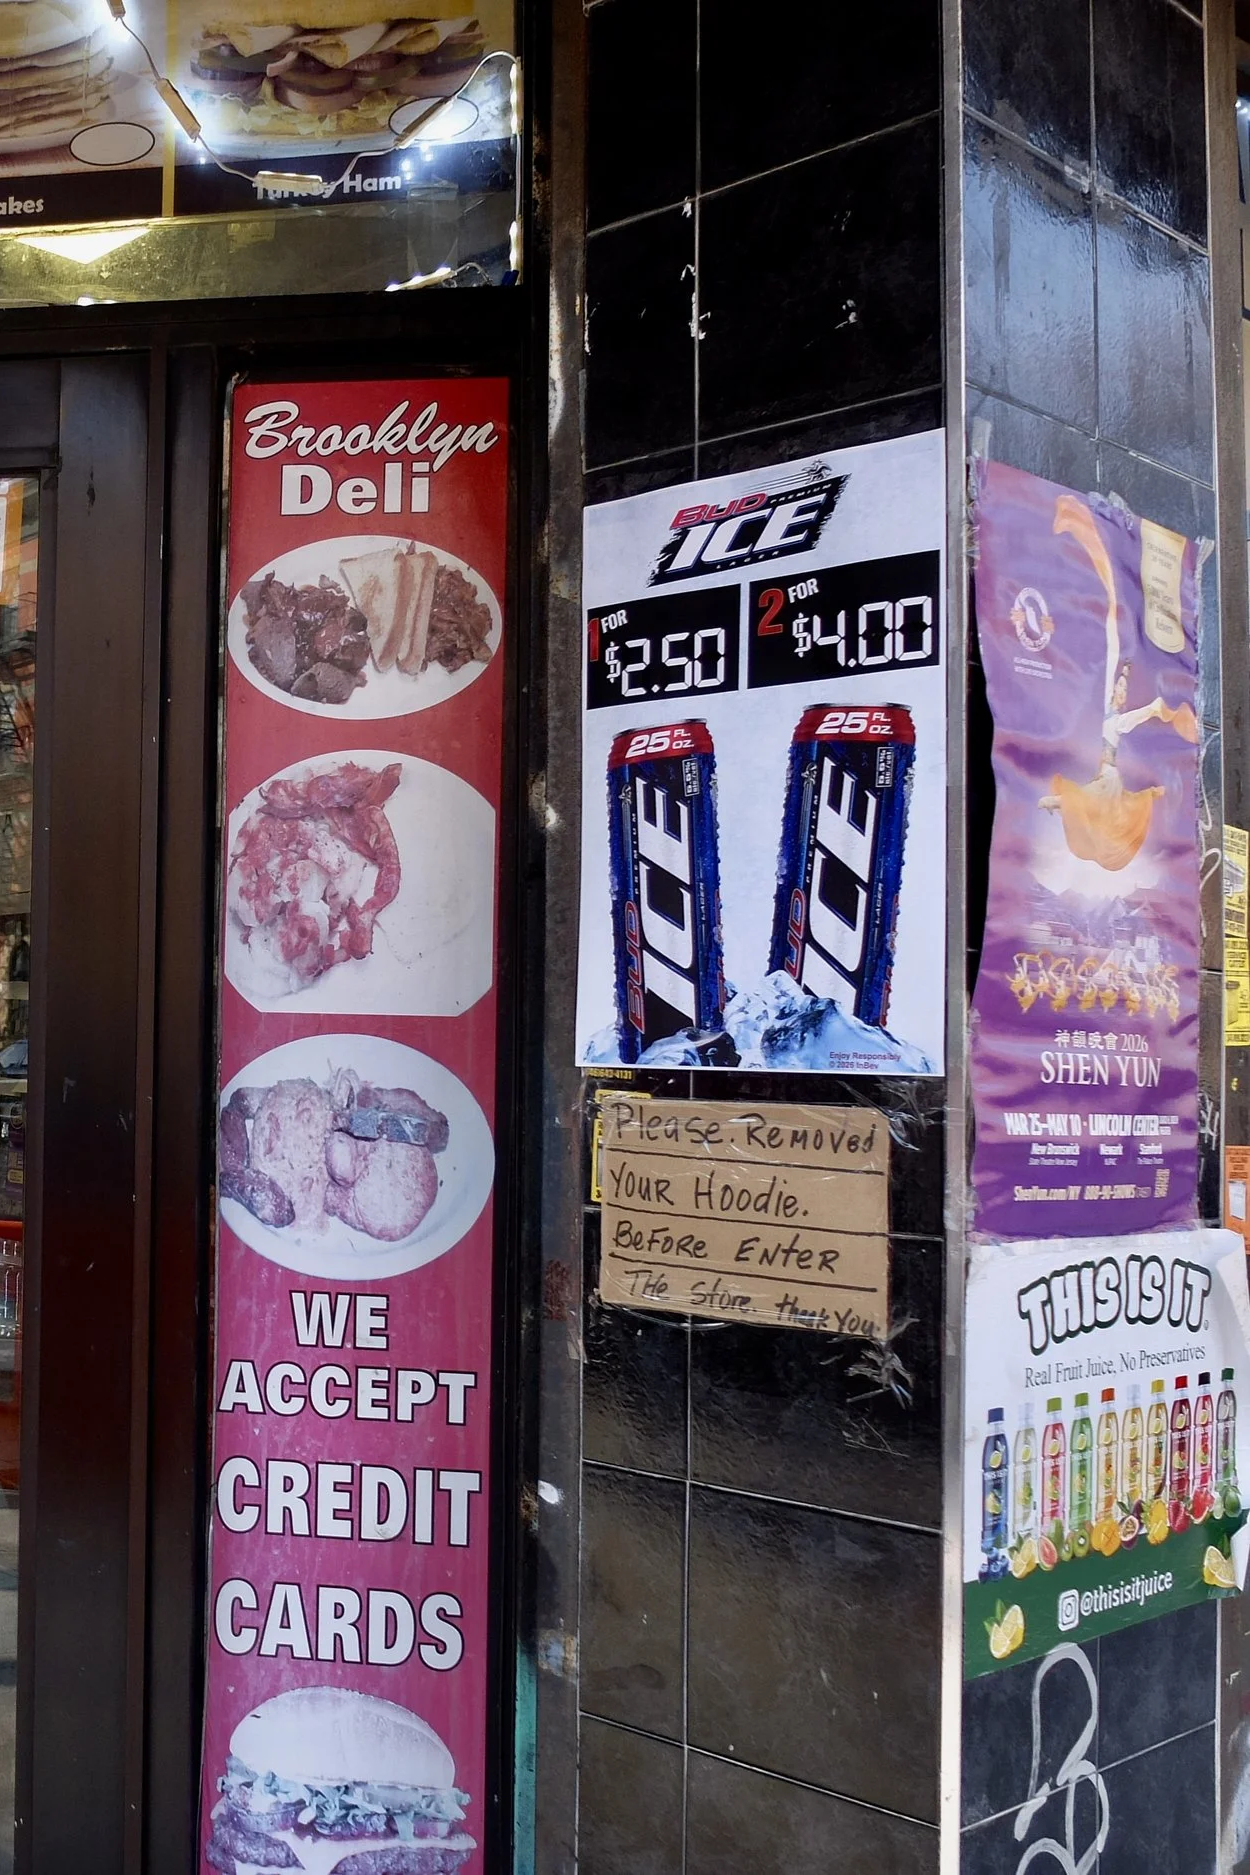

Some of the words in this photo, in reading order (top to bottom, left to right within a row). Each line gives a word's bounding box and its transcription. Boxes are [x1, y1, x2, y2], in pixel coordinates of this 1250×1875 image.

[252, 180, 338, 200] Tuy
[343, 174, 402, 194] Ham
[244, 400, 499, 472] Brooklyn
[280, 461, 431, 515] Deli
[665, 493, 829, 574] ICE
[600, 609, 628, 634] FOR
[757, 588, 785, 637] 2
[787, 578, 819, 604] FOR
[791, 595, 933, 669] $4.00
[604, 627, 726, 698] $2.50
[625, 730, 674, 759] 25
[814, 711, 870, 735] 25
[635, 776, 698, 1029] ICE
[784, 887, 808, 981] UD
[829, 1051, 851, 1060] Enjoy
[852, 1052, 901, 1062] Responsibly
[1040, 1050, 1110, 1086] SHEN
[1117, 1055, 1162, 1088] YUN
[1120, 1032, 1150, 1053] 2026
[1089, 1113, 1133, 1137] LINCOLN
[290, 1290, 390, 1350] WE
[1017, 1256, 1122, 1356] THIS
[1124, 1254, 1165, 1326] IS
[1168, 1258, 1212, 1333] IT
[217, 1360, 478, 1426] ACCEPT
[1025, 1363, 1052, 1388] Real
[1055, 1359, 1082, 1383] Fruit
[1086, 1356, 1117, 1378] Juice,
[1120, 1352, 1137, 1372] No
[1139, 1342, 1206, 1370] Preservatives
[216, 1455, 482, 1548] CREDIT
[1080, 1569, 1174, 1617] @thisisitjuice
[214, 1577, 465, 1672] CARDS
